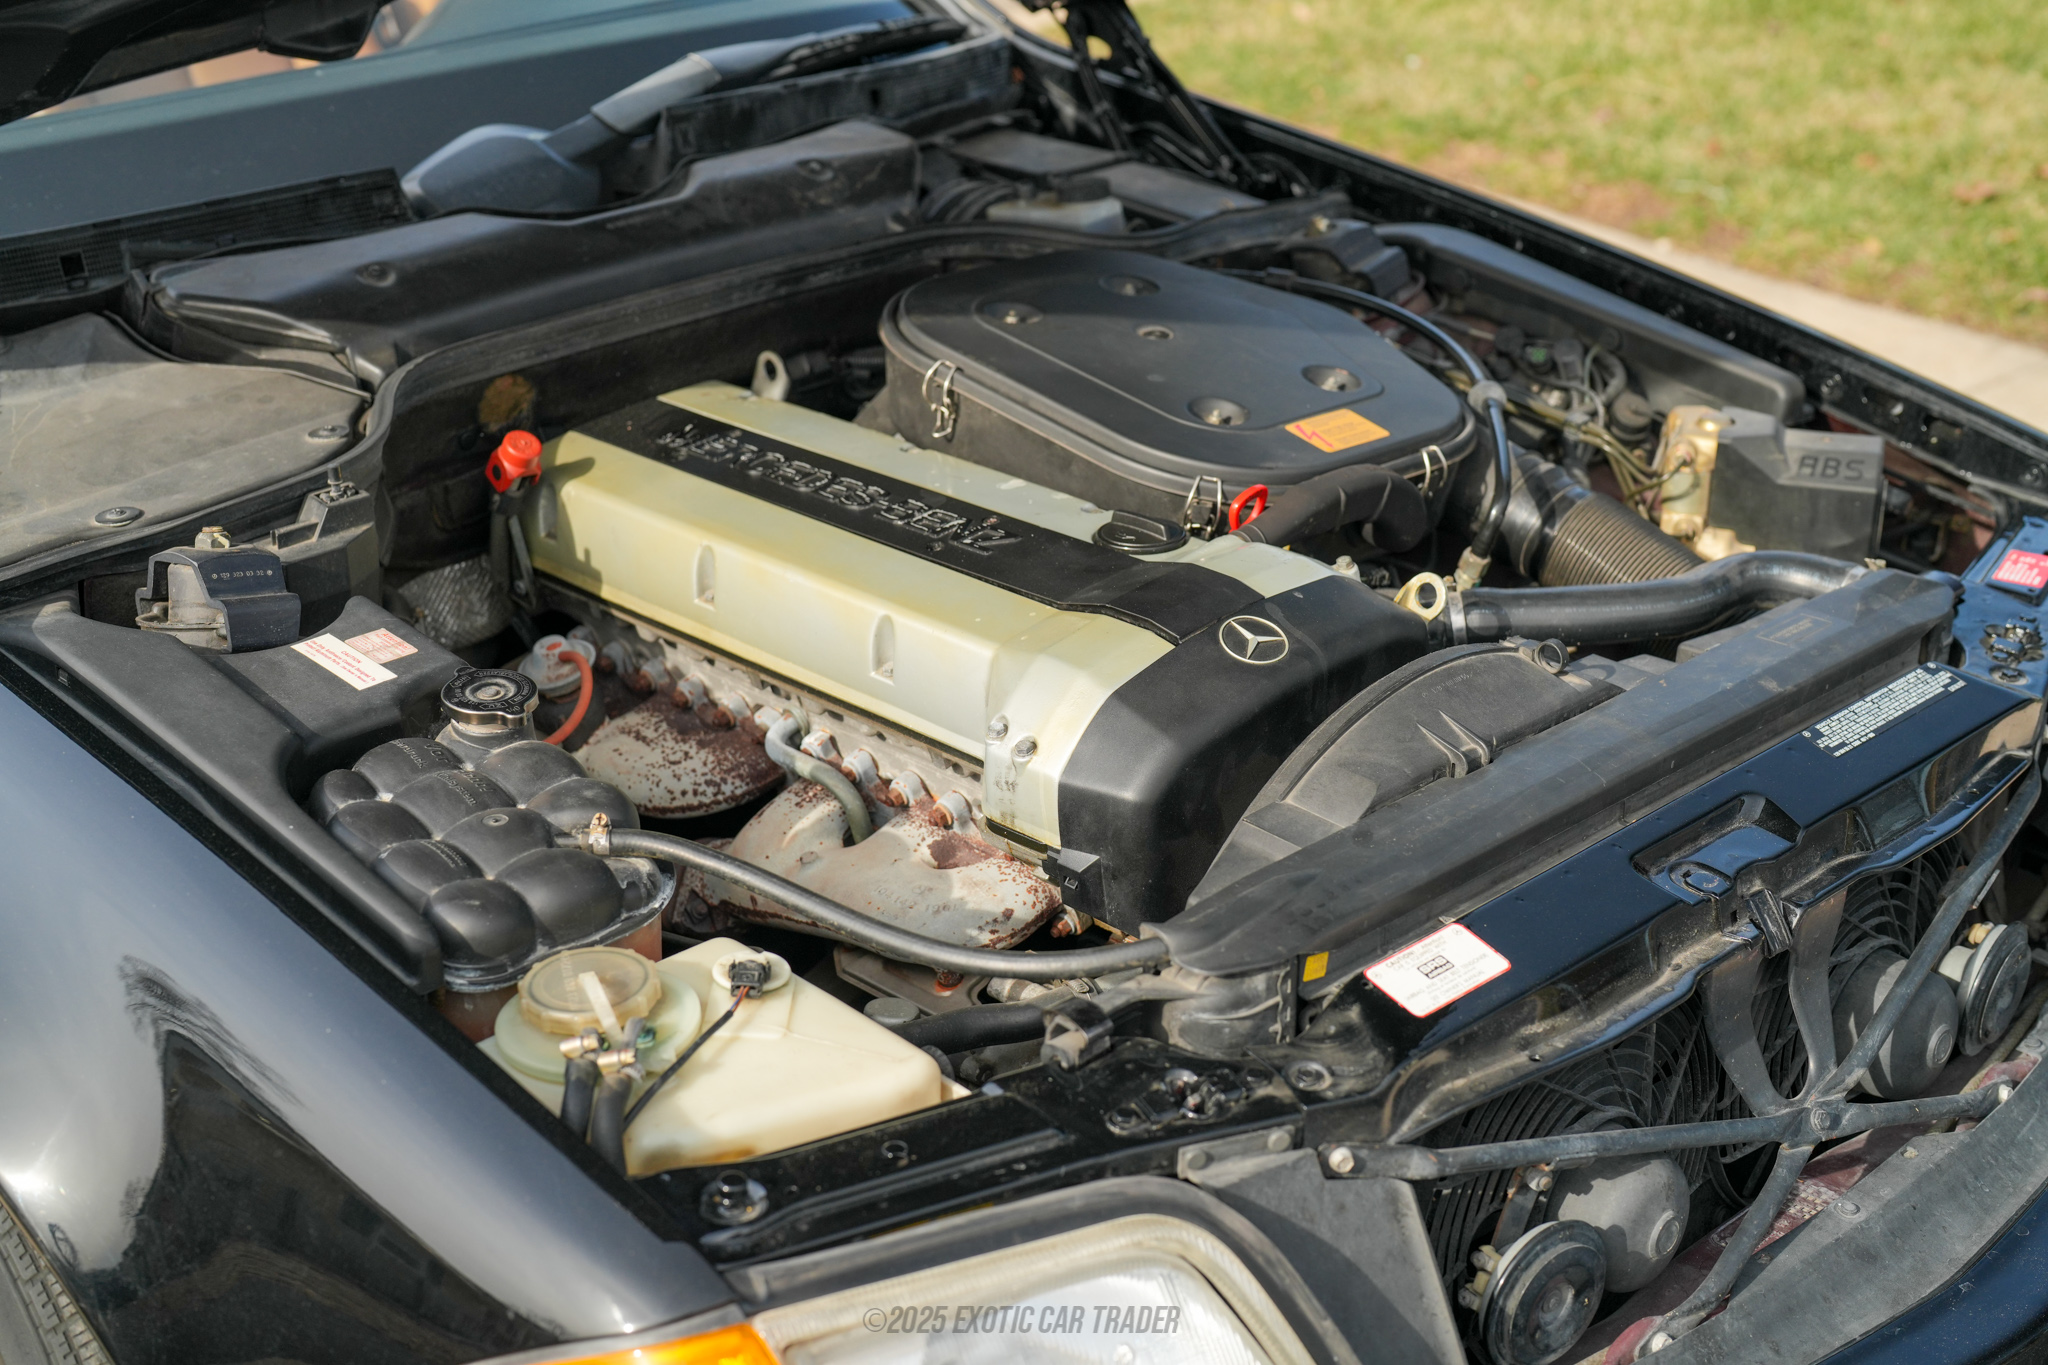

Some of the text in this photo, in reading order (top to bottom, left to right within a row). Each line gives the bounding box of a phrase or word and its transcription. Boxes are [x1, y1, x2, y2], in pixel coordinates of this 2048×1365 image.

[1798, 455, 1866, 480] ABS
[655, 423, 1023, 556] MERCEDES-BENZ
[1421, 956, 1448, 974] SRS
